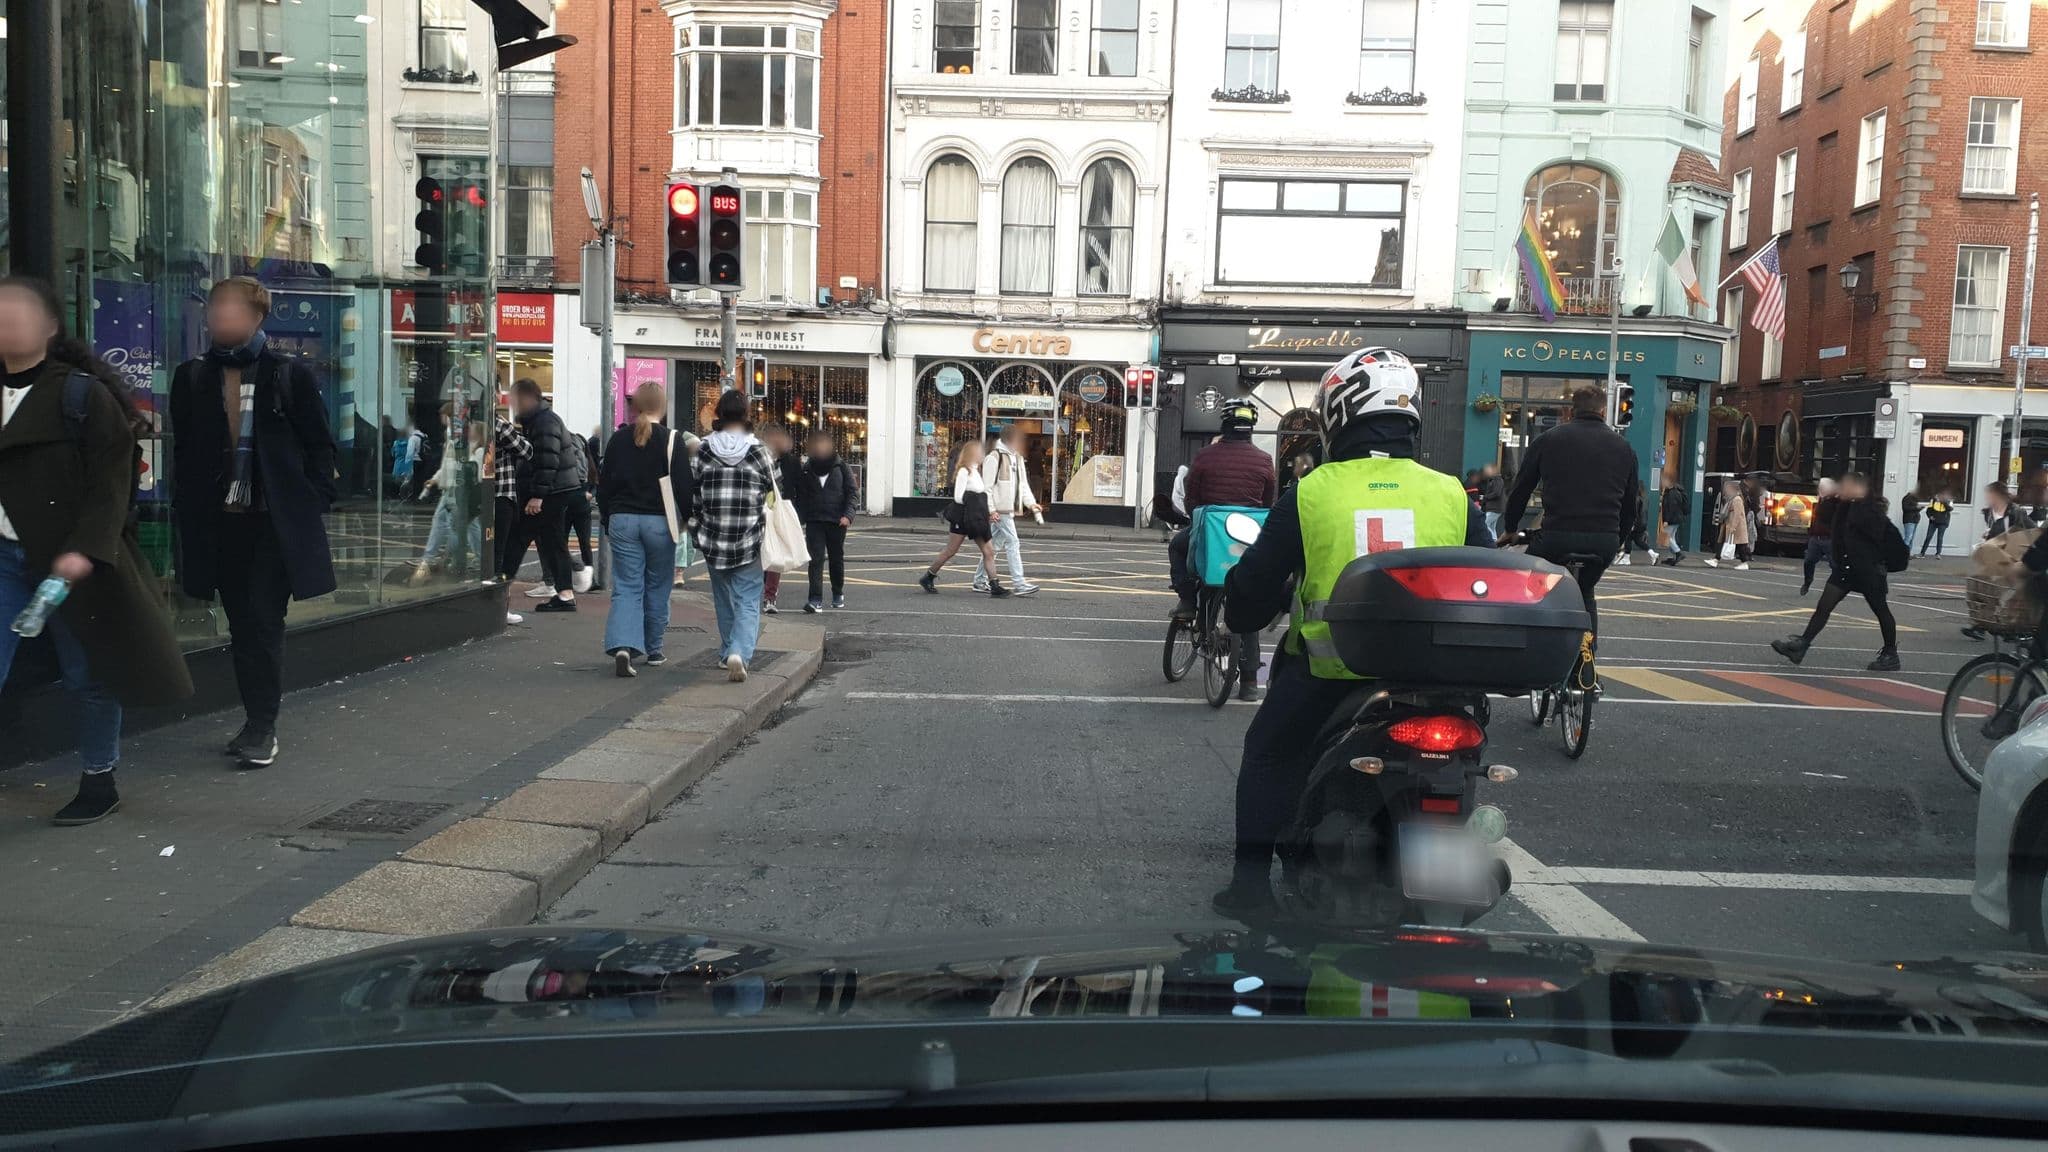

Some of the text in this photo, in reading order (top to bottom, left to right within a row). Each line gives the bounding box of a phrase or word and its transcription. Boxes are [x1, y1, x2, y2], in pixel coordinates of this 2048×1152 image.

[713, 197, 737, 209] BUS
[756, 331, 805, 342] HONEST
[972, 327, 1072, 355] Centra
[1504, 348, 1527, 359] KC
[1928, 434, 1959, 443] BUNSEN
[1366, 517, 1404, 555] L
[1420, 752, 1450, 760] SUZUKI
